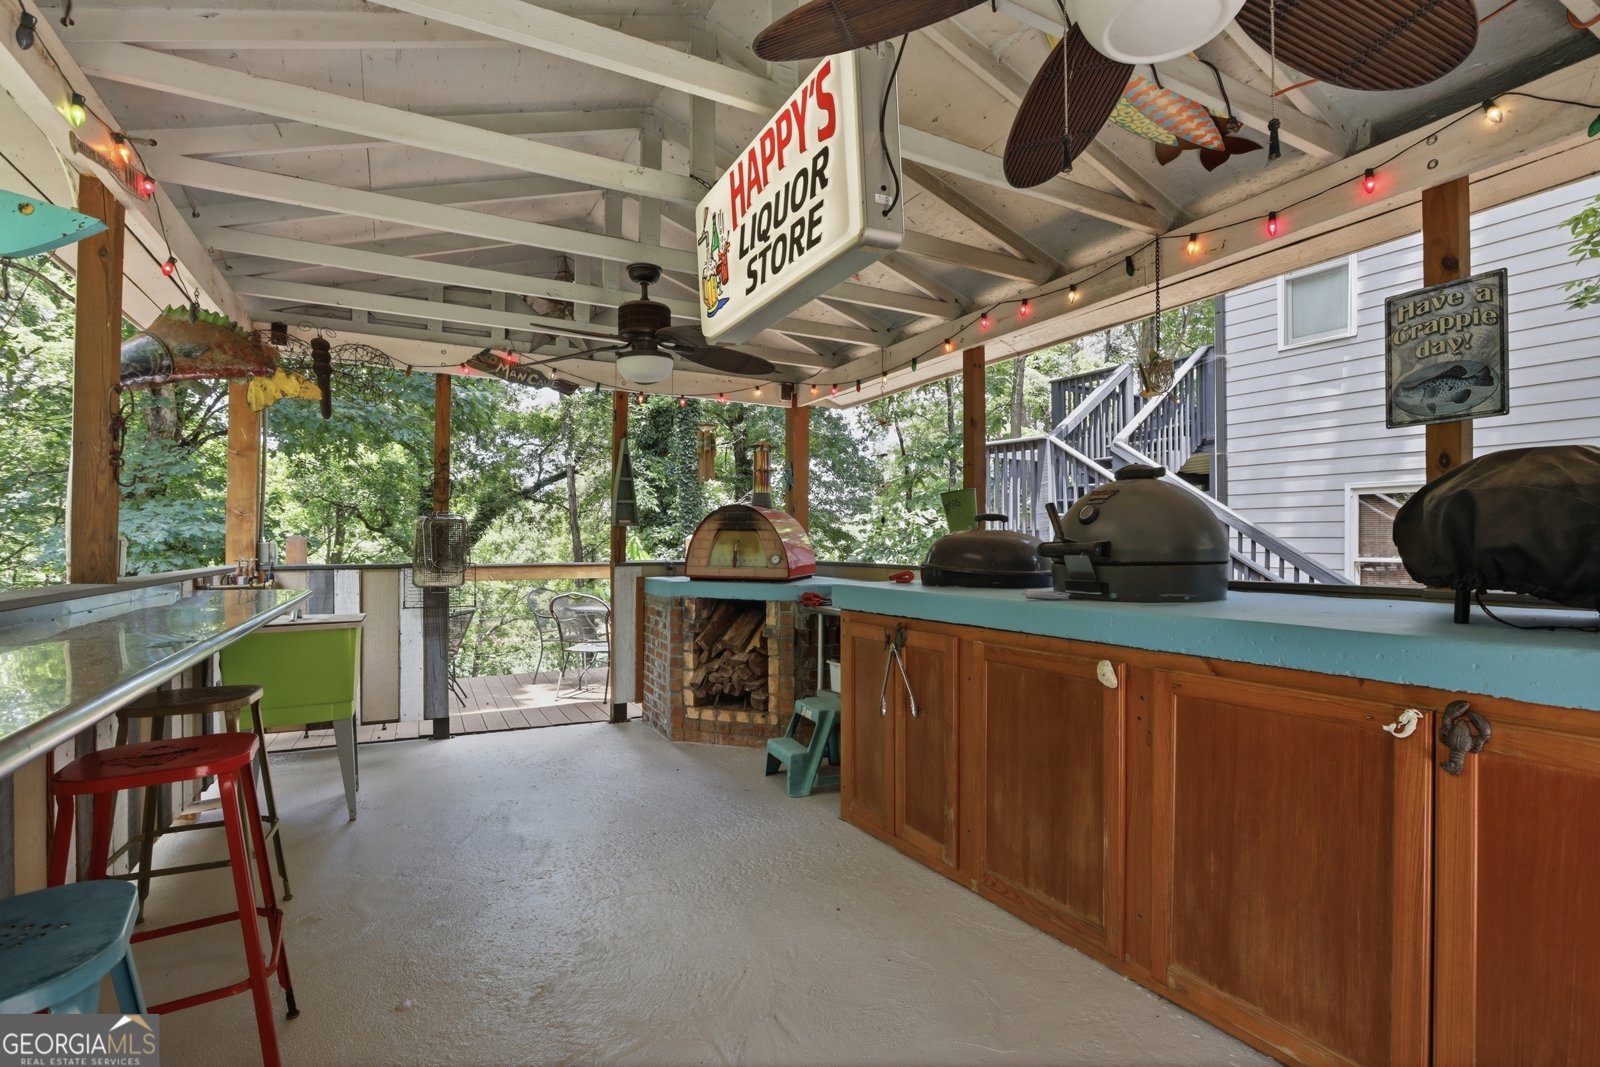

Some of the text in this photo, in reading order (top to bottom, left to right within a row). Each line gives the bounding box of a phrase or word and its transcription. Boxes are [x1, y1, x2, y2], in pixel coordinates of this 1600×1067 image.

[729, 60, 836, 231] HAPPY'S
[738, 145, 829, 260] LIQUOR
[745, 199, 825, 296] STORE
[1392, 307, 1498, 346] Crappie
[1397, 286, 1493, 324] Have a
[1415, 331, 1473, 360] day!
